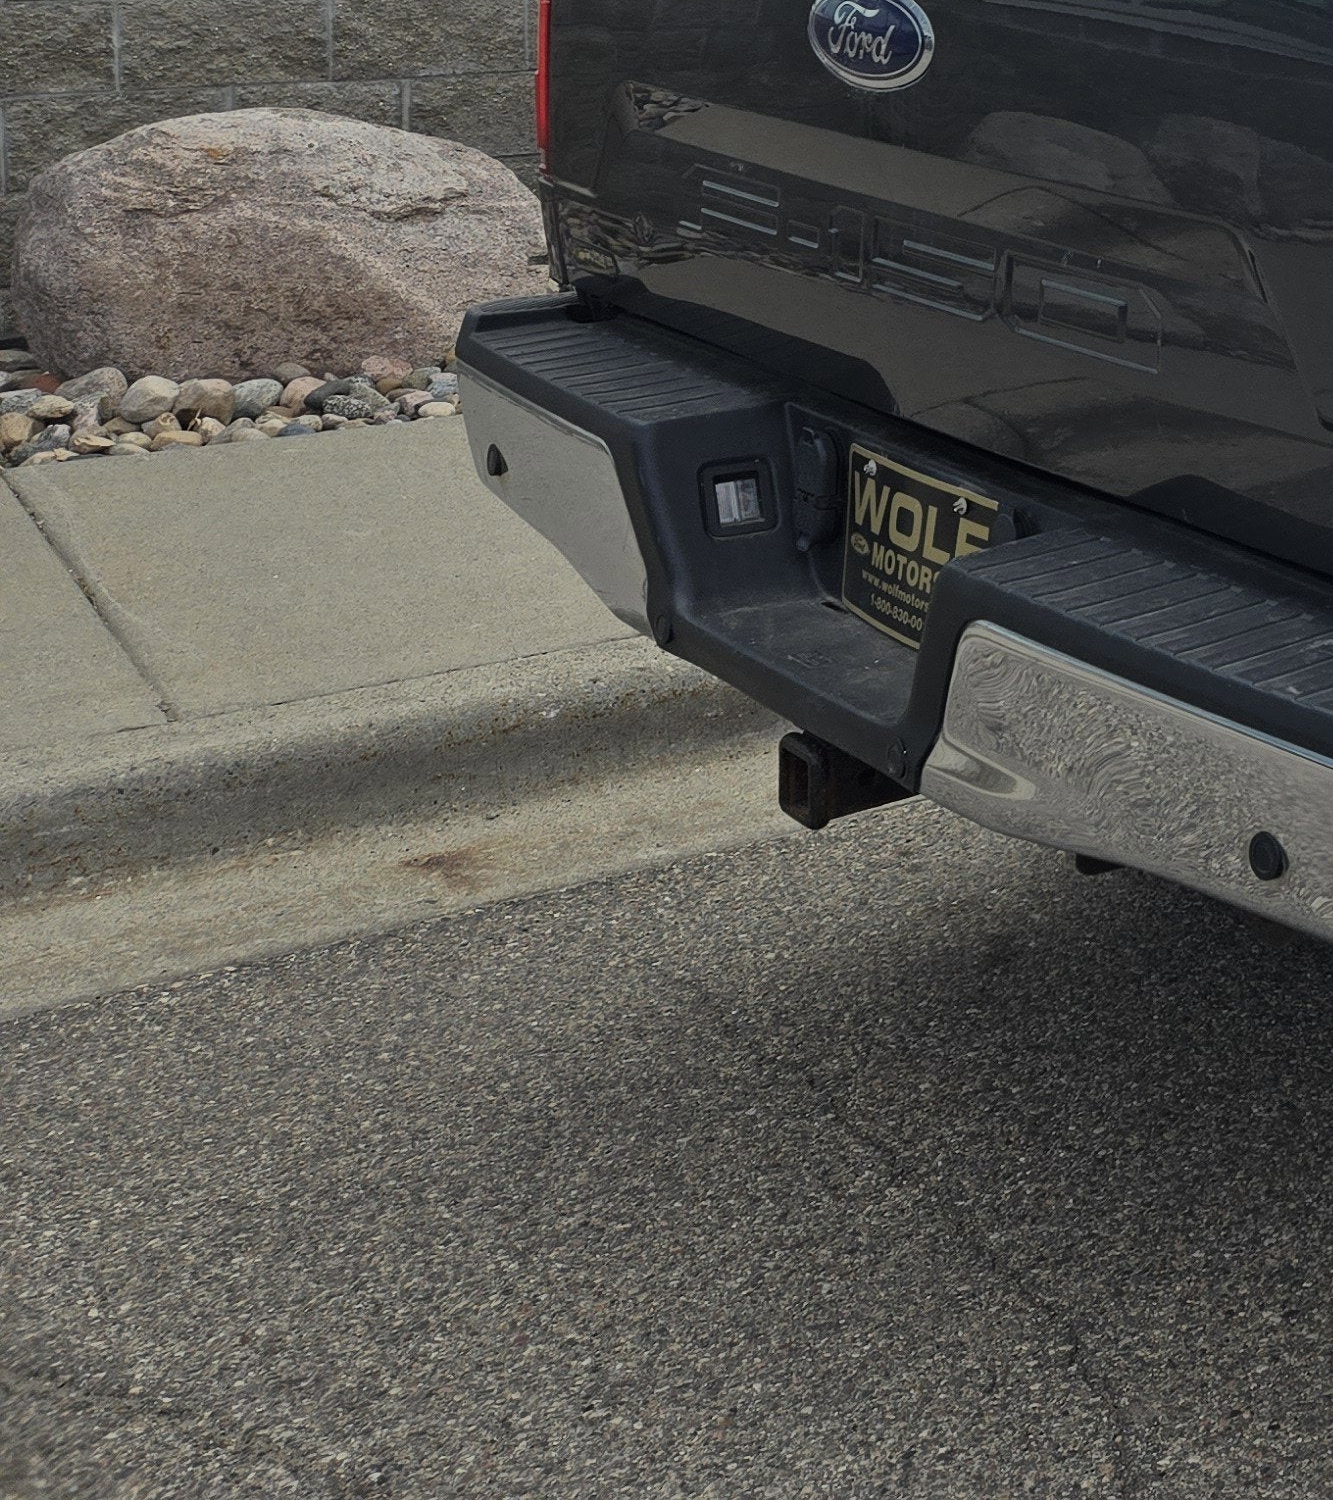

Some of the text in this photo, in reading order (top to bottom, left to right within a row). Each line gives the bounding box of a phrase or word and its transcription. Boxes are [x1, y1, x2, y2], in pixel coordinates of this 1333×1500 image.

[828, 0, 895, 64] Ford
[854, 471, 990, 566] WOLF
[861, 568, 930, 613] www.wolfmotors
[870, 593, 923, 631] 1-800-830-00
